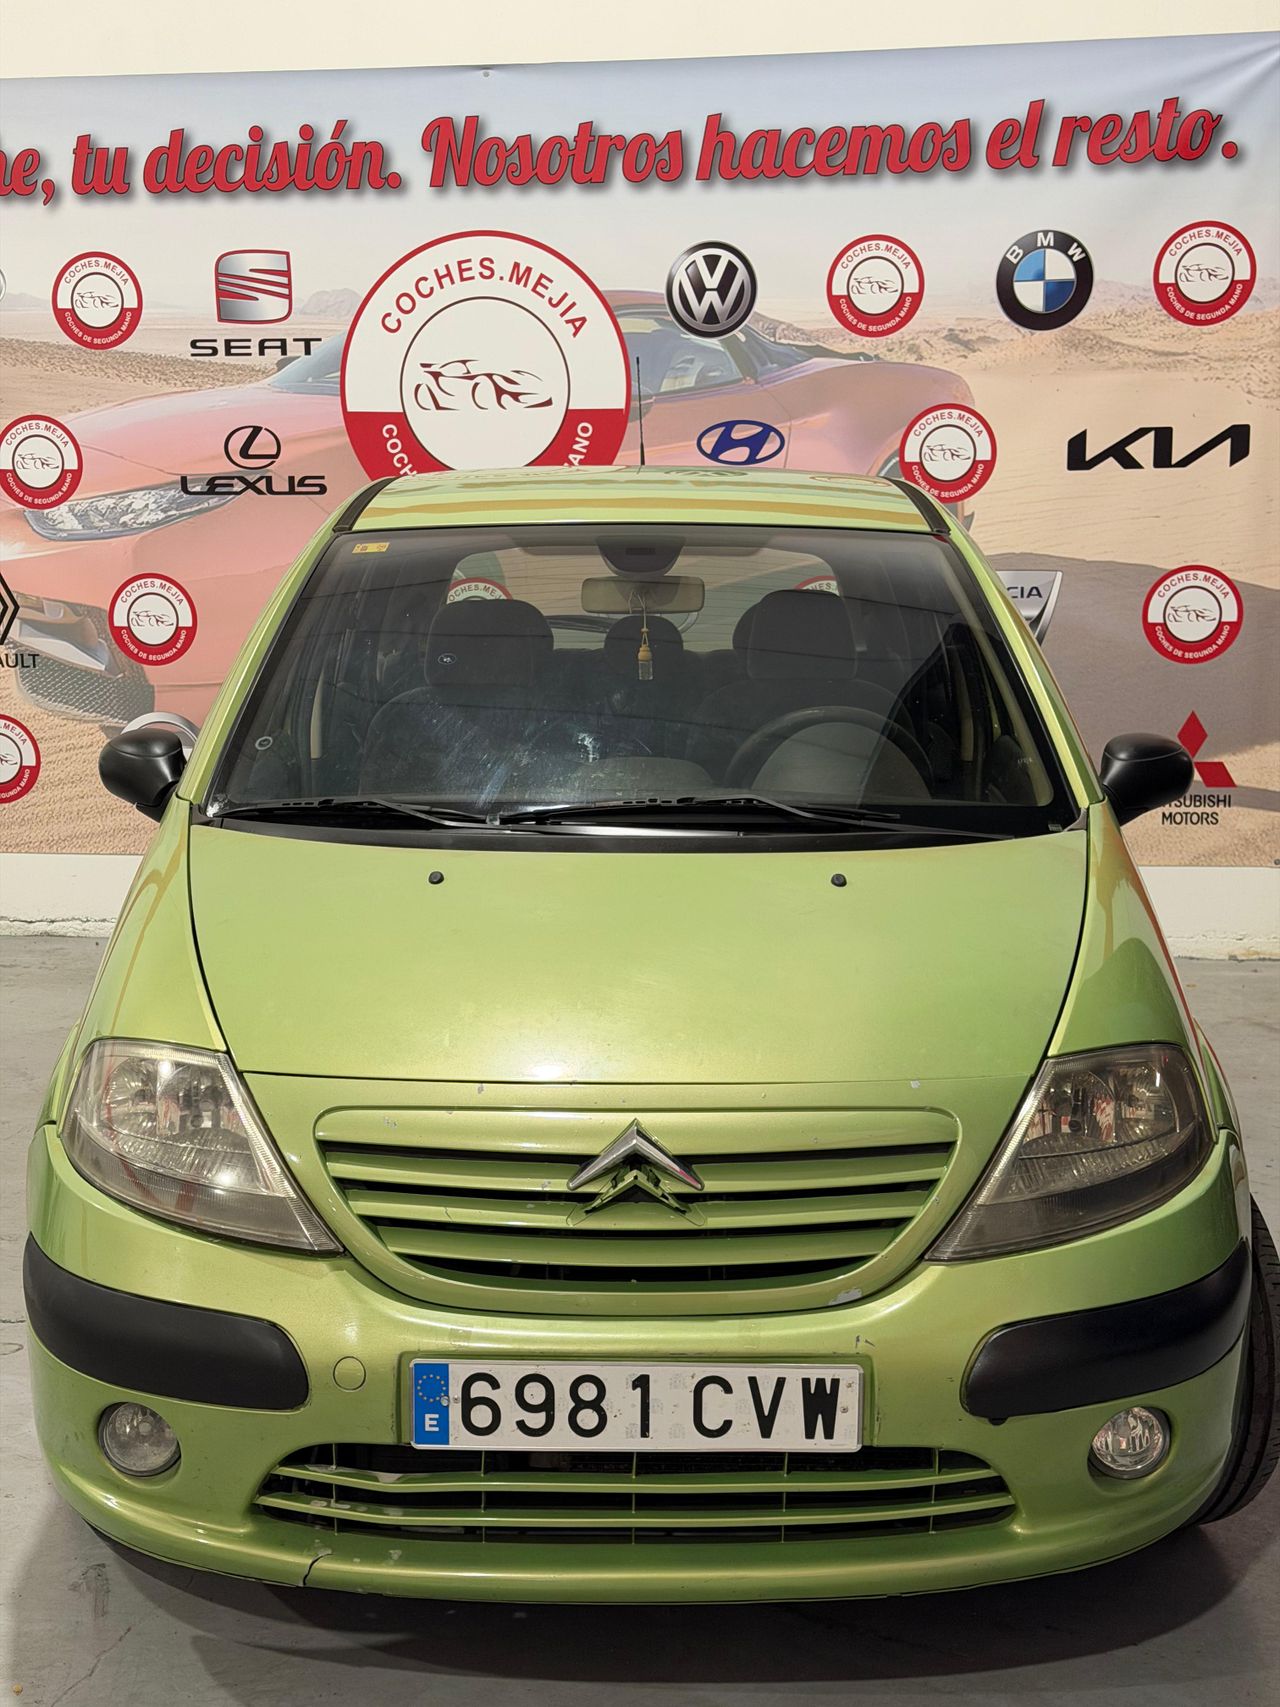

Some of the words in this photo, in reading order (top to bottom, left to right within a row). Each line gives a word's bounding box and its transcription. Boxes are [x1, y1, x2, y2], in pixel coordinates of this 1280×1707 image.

[72, 134, 130, 195] tu
[143, 120, 402, 194] decisión.
[422, 115, 684, 187] Nosotros
[696, 113, 972, 182] hacemos
[986, 98, 1046, 169] el
[1053, 97, 1239, 167] resto.
[1005, 231, 1087, 265] BMW
[381, 257, 588, 339] COCHES.MEJIA
[839, 298, 858, 325] COCHES
[857, 322, 867, 331] DE
[868, 316, 901, 331] SEGUNDA
[898, 296, 912, 318] MANO
[1166, 286, 1185, 314] COCHES
[1184, 310, 1195, 319] DE
[1196, 305, 1231, 320] SEGUNDA
[1228, 283, 1243, 306] MANO
[64, 311, 83, 337] COCHES
[83, 334, 92, 343] DE
[93, 330, 123, 344] SEGUNDA
[120, 311, 132, 332] MANO
[190, 337, 322, 357] SEAT
[563, 421, 593, 466] ANO
[6, 472, 24, 498] COCHES
[24, 494, 33, 503] DE
[34, 491, 63, 505] SEGUNDA
[61, 472, 72, 492] MANO
[180, 475, 328, 496] LEXUS
[912, 465, 930, 491] COCHES
[929, 488, 939, 497] DE
[940, 483, 974, 498] SEGUNDA
[971, 463, 984, 484] MANO
[121, 629, 139, 654] COCHES
[138, 651, 147, 660] DE
[148, 647, 178, 661] SEGUNDA
[175, 629, 187, 649] MANO
[1155, 625, 1174, 652] COCHES
[1172, 648, 1183, 658] DE
[1184, 643, 1219, 659] SEGUNDA
[1216, 624, 1230, 646] MANO
[20, 768, 30, 788] MANO
[1161, 811, 1219, 825] MOTORS
[424, 1413, 440, 1432] E
[460, 1371, 651, 1439] 6981
[692, 1374, 841, 1441] CVW
